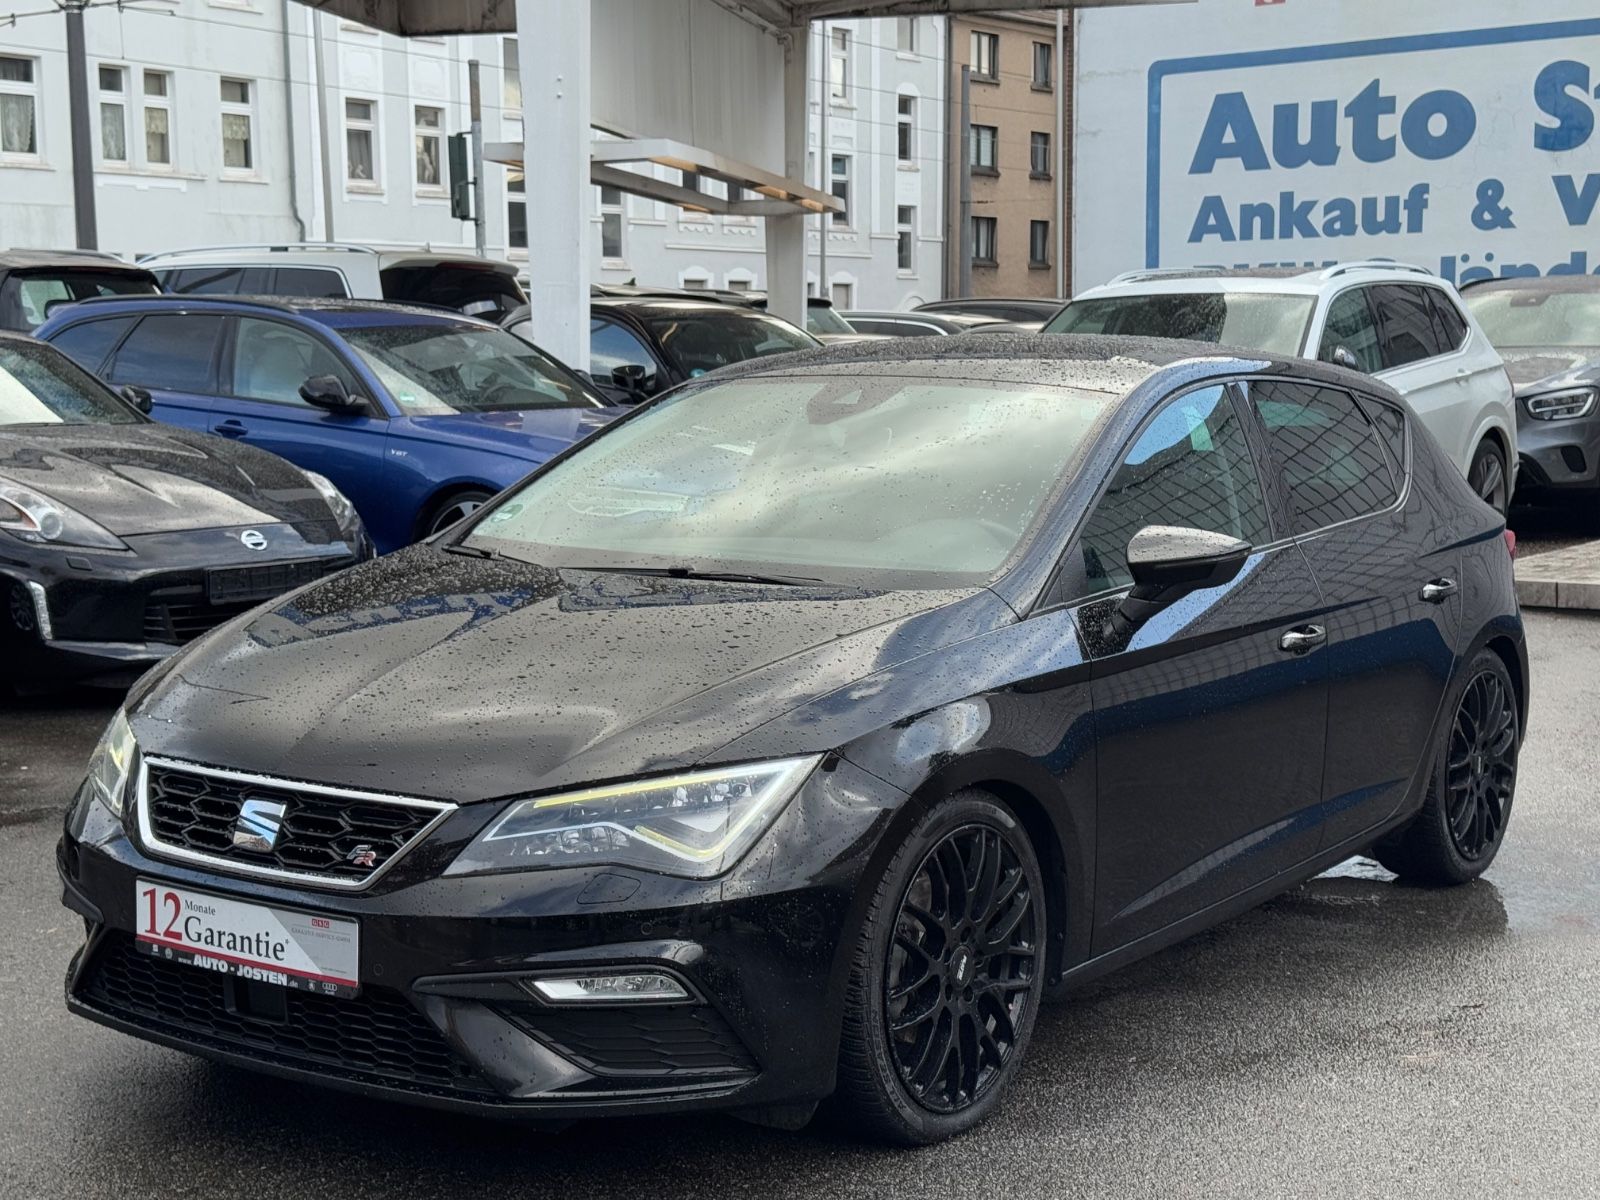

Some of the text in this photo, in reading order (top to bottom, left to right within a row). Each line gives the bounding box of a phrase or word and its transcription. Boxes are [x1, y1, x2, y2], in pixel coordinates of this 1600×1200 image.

[1188, 60, 1600, 175] Auto S
[1187, 183, 1430, 243] Ankauf
[1471, 178, 1517, 231] &
[143, 887, 183, 942] 12
[184, 899, 216, 916] Monate
